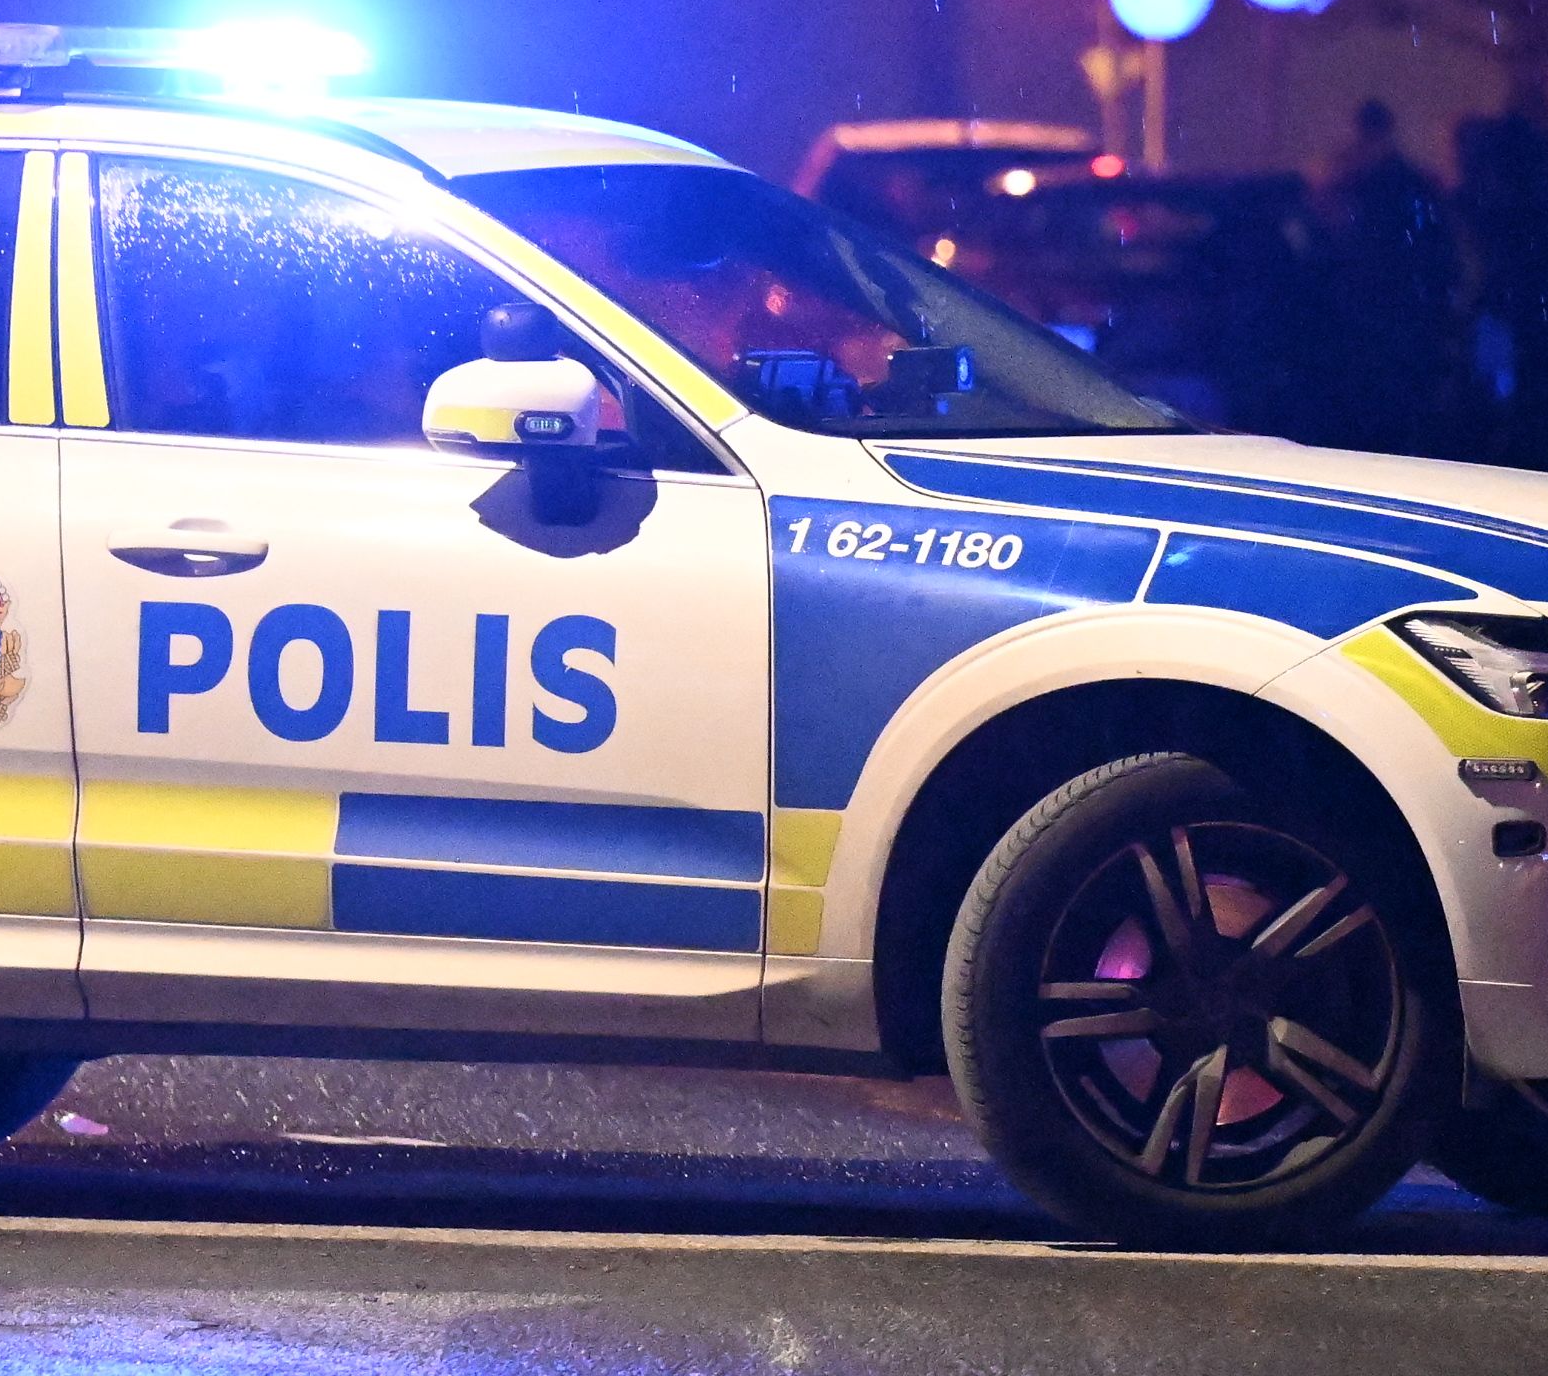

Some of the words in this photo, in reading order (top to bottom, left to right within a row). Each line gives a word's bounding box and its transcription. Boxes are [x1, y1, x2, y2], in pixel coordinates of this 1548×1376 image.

[788, 517, 812, 553] 1
[826, 520, 1023, 571] 62-1180
[136, 600, 618, 754] POLIS
